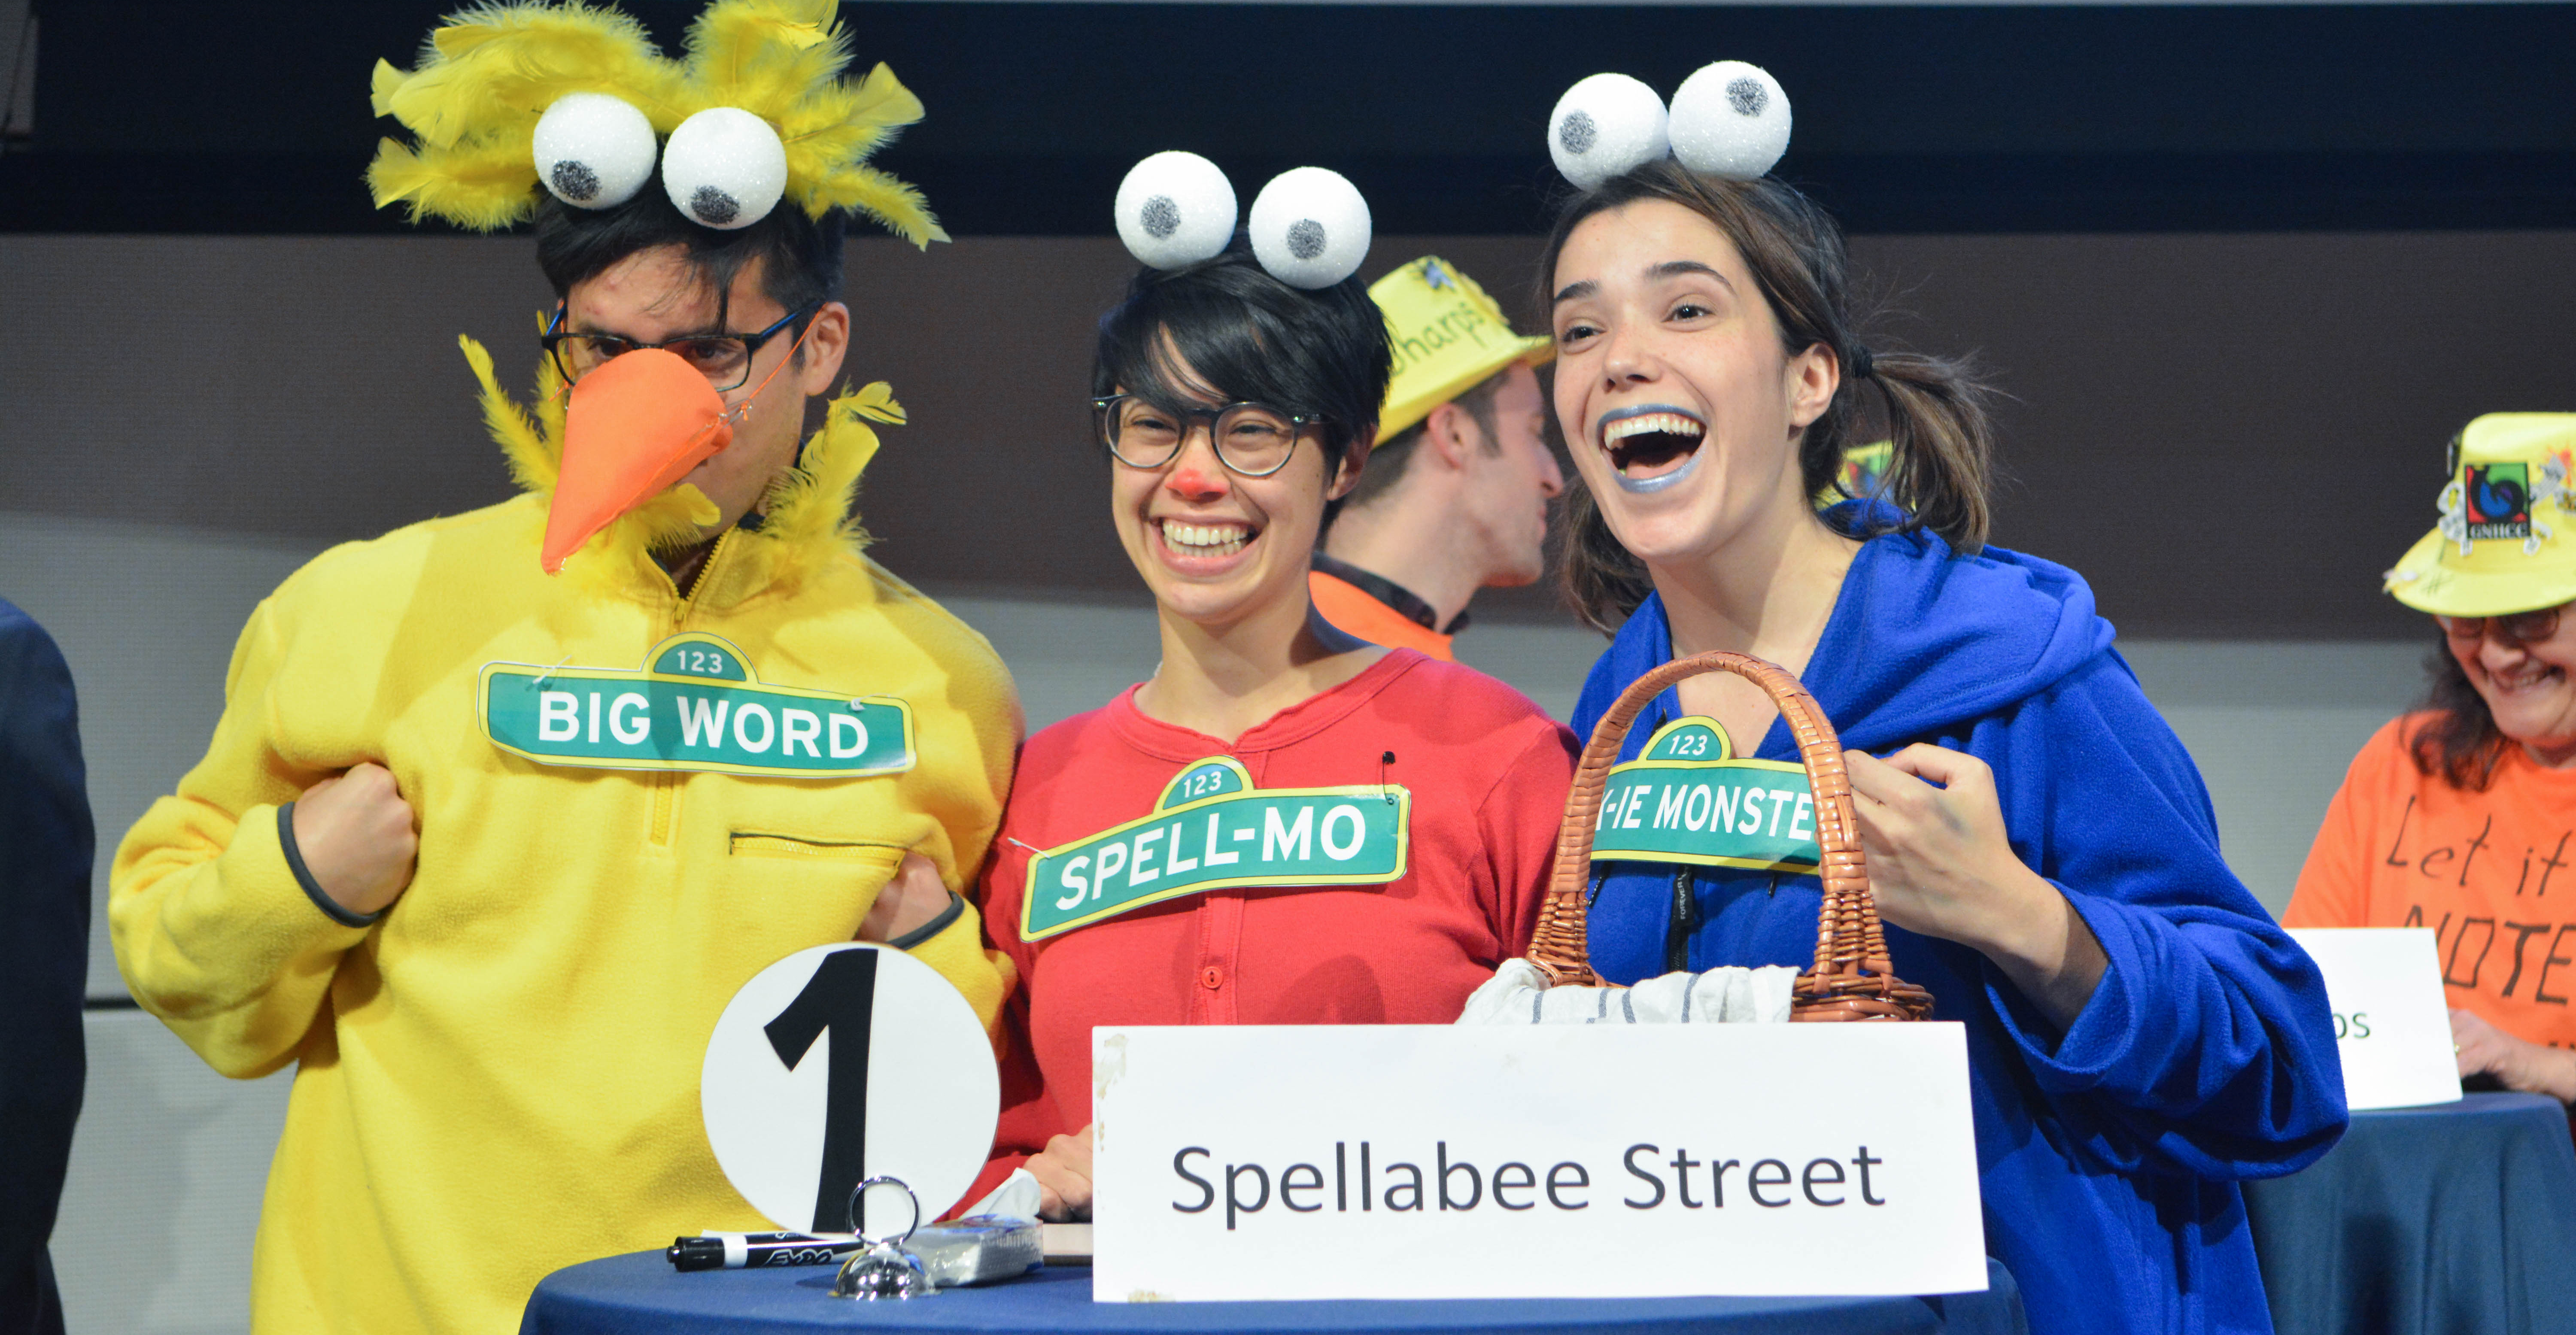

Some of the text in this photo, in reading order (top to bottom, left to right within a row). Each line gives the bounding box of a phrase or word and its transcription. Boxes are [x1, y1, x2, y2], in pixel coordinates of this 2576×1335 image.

[677, 650, 722, 673] 123
[539, 691, 869, 759] BIG WORD
[1668, 735, 1708, 755] 123
[1184, 771, 1221, 798] 123
[1056, 804, 1366, 910] SPELL-MO
[2387, 795, 2572, 896] Let it
[1677, 881, 1686, 919] FOREVER
[763, 948, 879, 1234] 1
[1173, 1141, 1886, 1230] Spellabee Street
